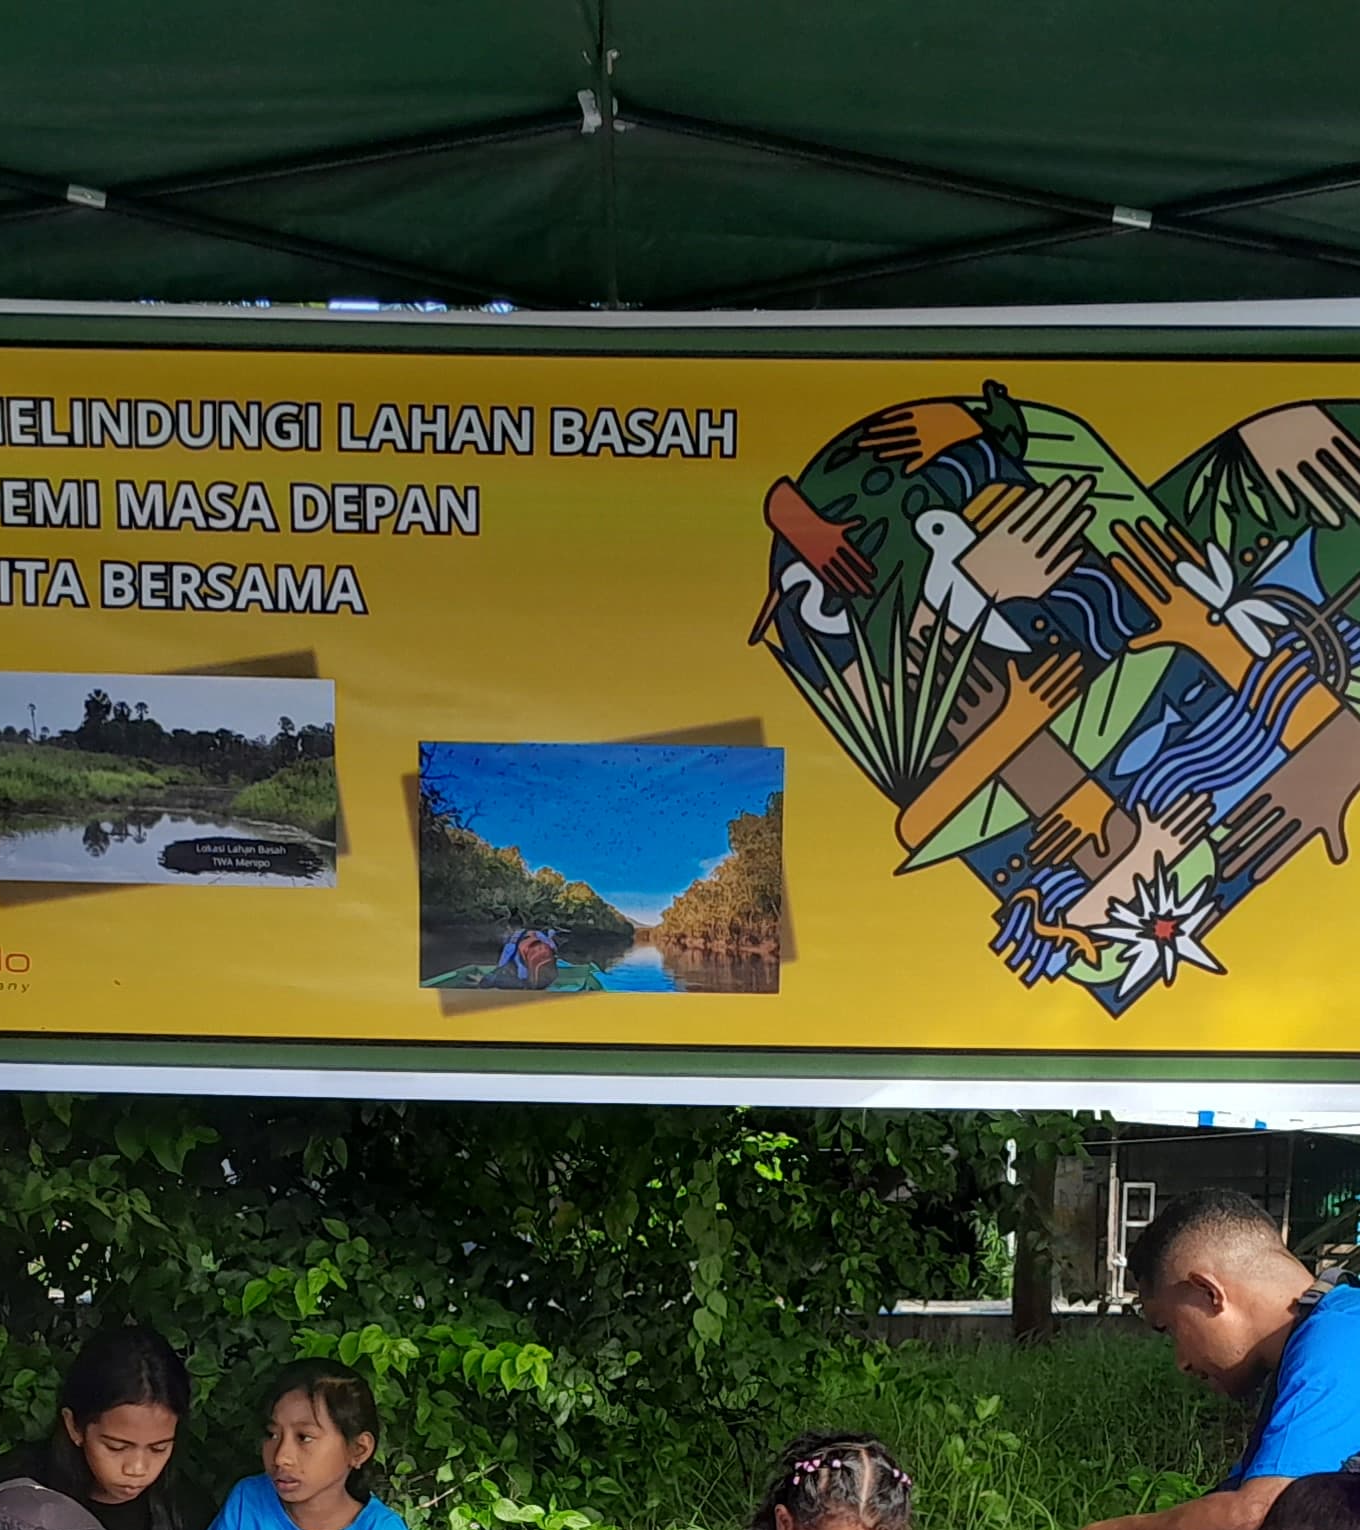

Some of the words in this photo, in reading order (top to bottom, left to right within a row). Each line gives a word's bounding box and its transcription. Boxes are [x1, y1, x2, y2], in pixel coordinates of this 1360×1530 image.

[337, 402, 533, 456] LAHAN
[550, 407, 737, 458] BASAH
[116, 479, 280, 533] MASA
[290, 483, 481, 536] DEPAN
[100, 560, 368, 615] BERSAMA
[196, 843, 225, 853] Lokasi
[227, 844, 256, 855] Lahan
[258, 845, 287, 855] Basah
[213, 857, 233, 866] TWA
